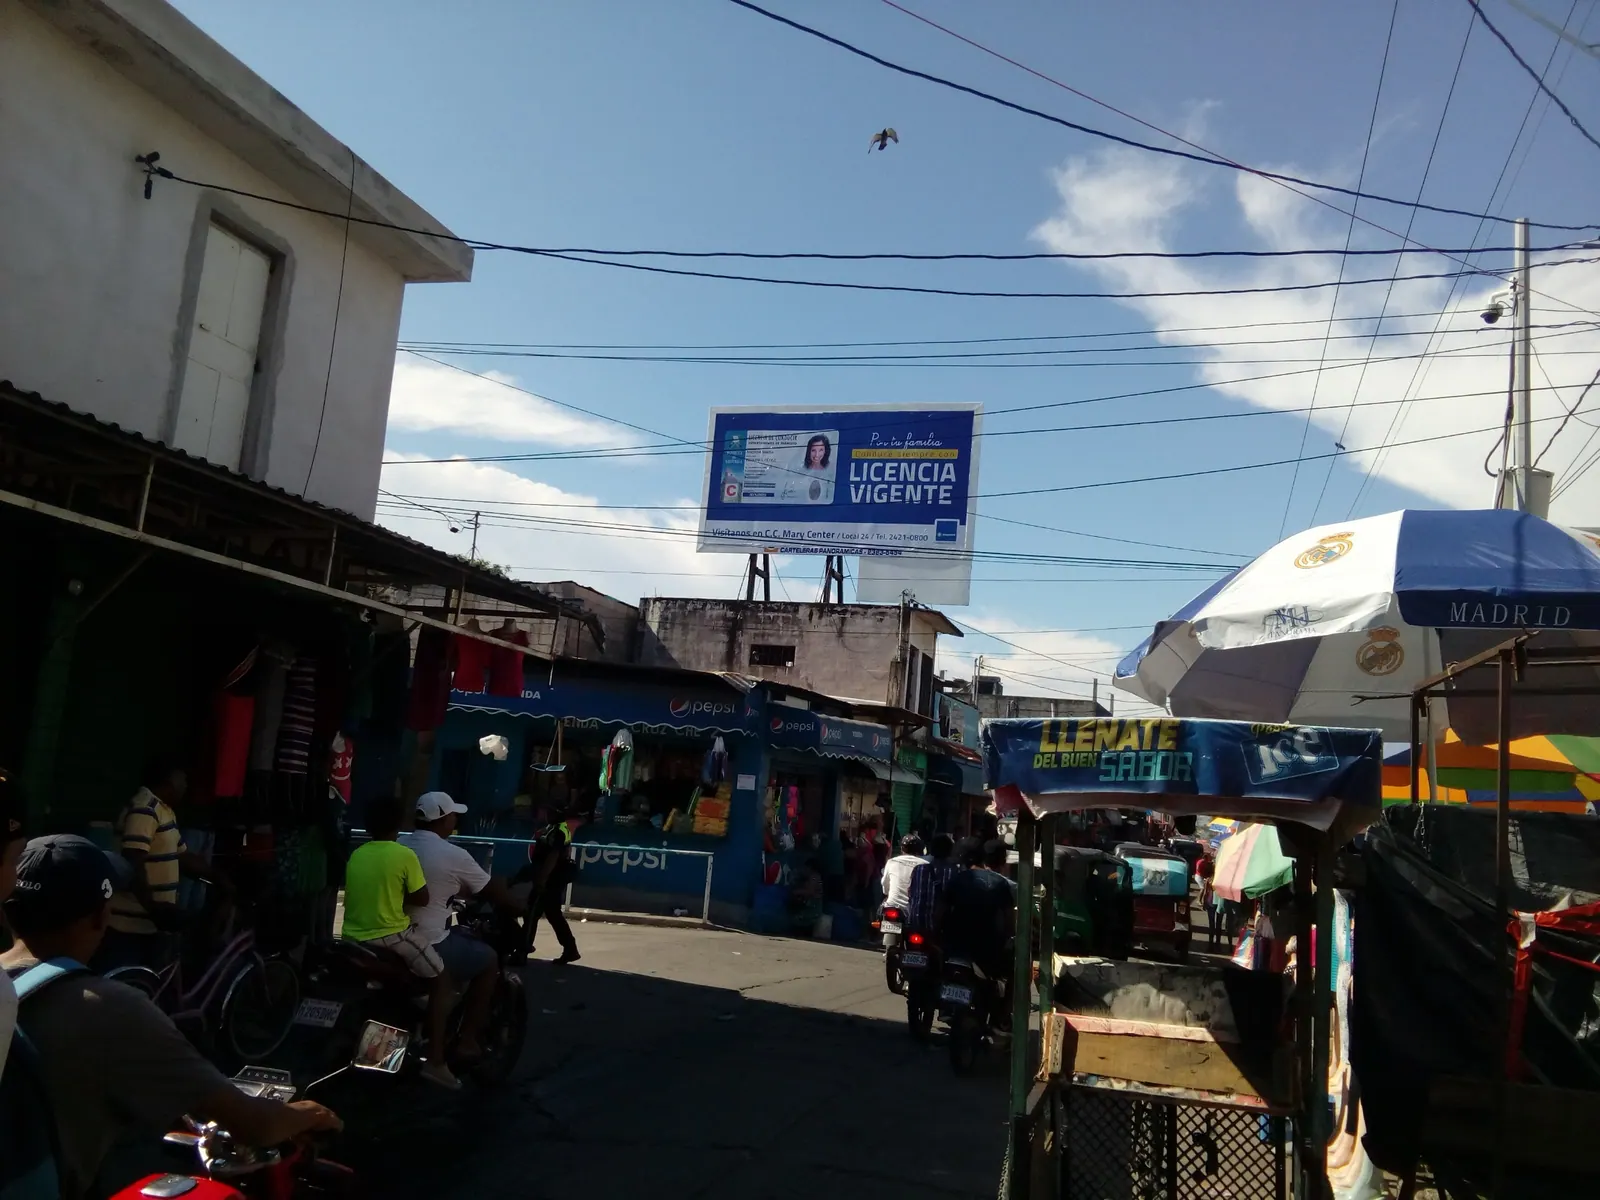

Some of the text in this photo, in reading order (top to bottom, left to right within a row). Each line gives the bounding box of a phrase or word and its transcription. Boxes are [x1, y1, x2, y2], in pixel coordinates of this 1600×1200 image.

[903, 431, 942, 450] familia
[938, 450, 955, 458] con
[849, 462, 956, 482] LICENCIA
[850, 484, 953, 504] VIGENTE
[783, 530, 804, 540] Mary
[807, 530, 835, 539] Center
[842, 532, 860, 540] Local
[889, 533, 929, 541] 2421-0800
[1449, 601, 1571, 627] MADRID
[692, 700, 737, 716] pepsi
[785, 720, 815, 733] pepsi
[1033, 751, 1193, 782] DEL BUEN SABOR
[579, 840, 667, 874] pepsi
